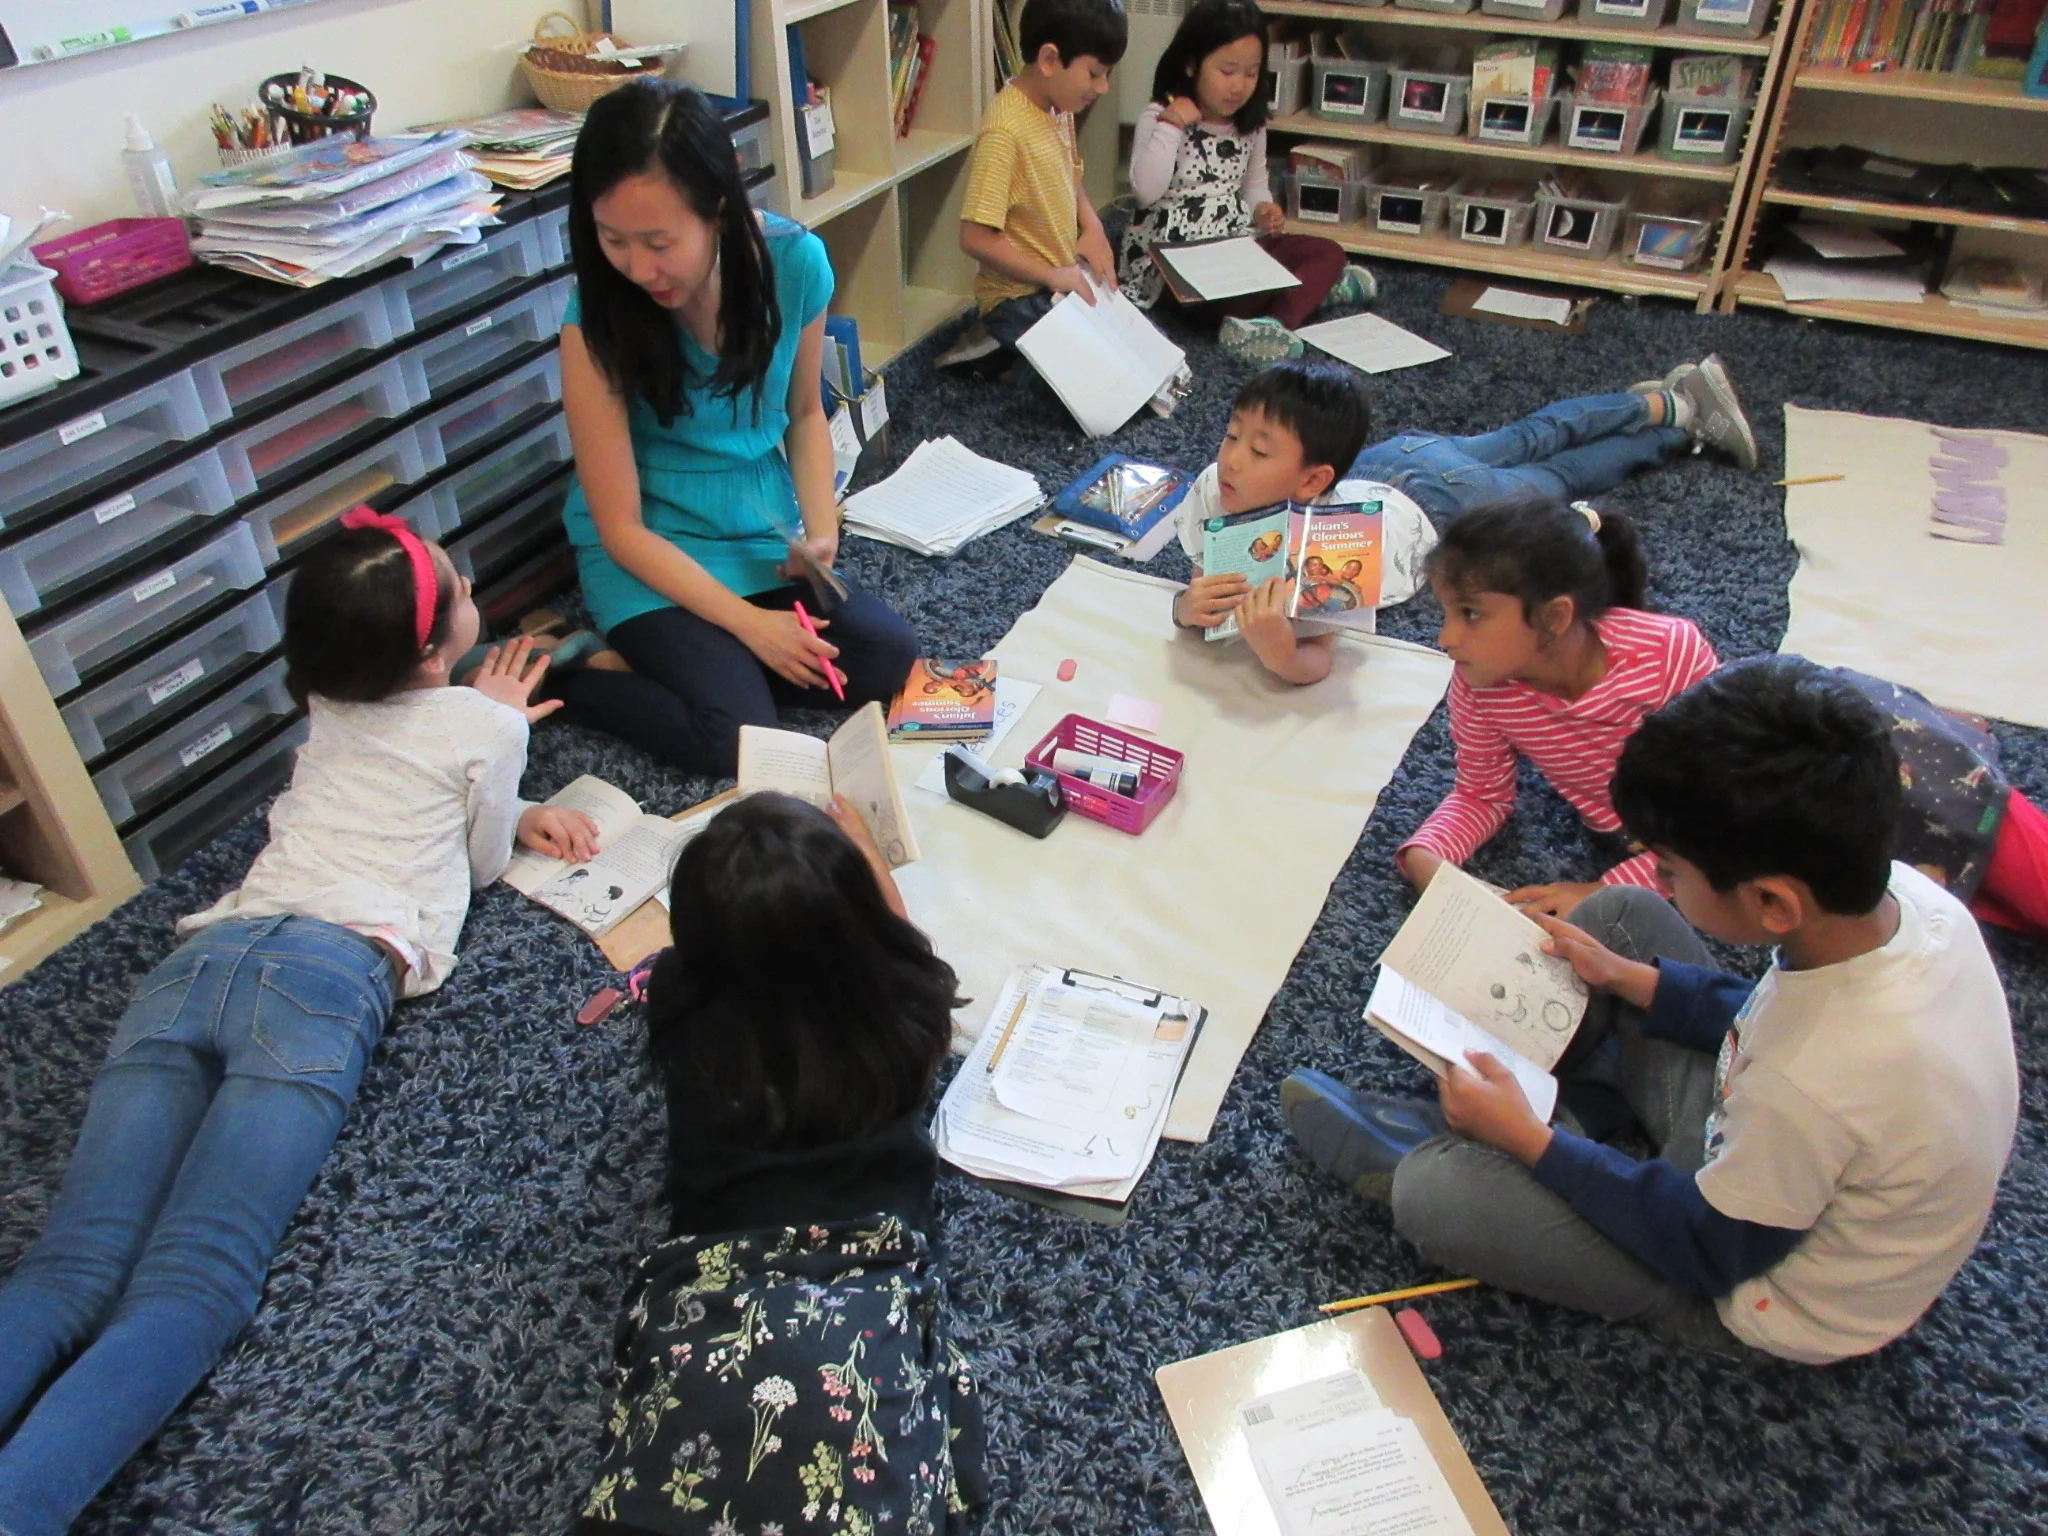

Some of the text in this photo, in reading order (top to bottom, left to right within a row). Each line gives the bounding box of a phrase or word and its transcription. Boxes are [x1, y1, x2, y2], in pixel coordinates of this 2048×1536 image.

[1307, 521, 1349, 531] ulian's
[1311, 531, 1364, 541] Glorious
[1320, 540, 1373, 551] Summer
[919, 705, 970, 713] Glorious
[933, 711, 977, 719] Julian's
